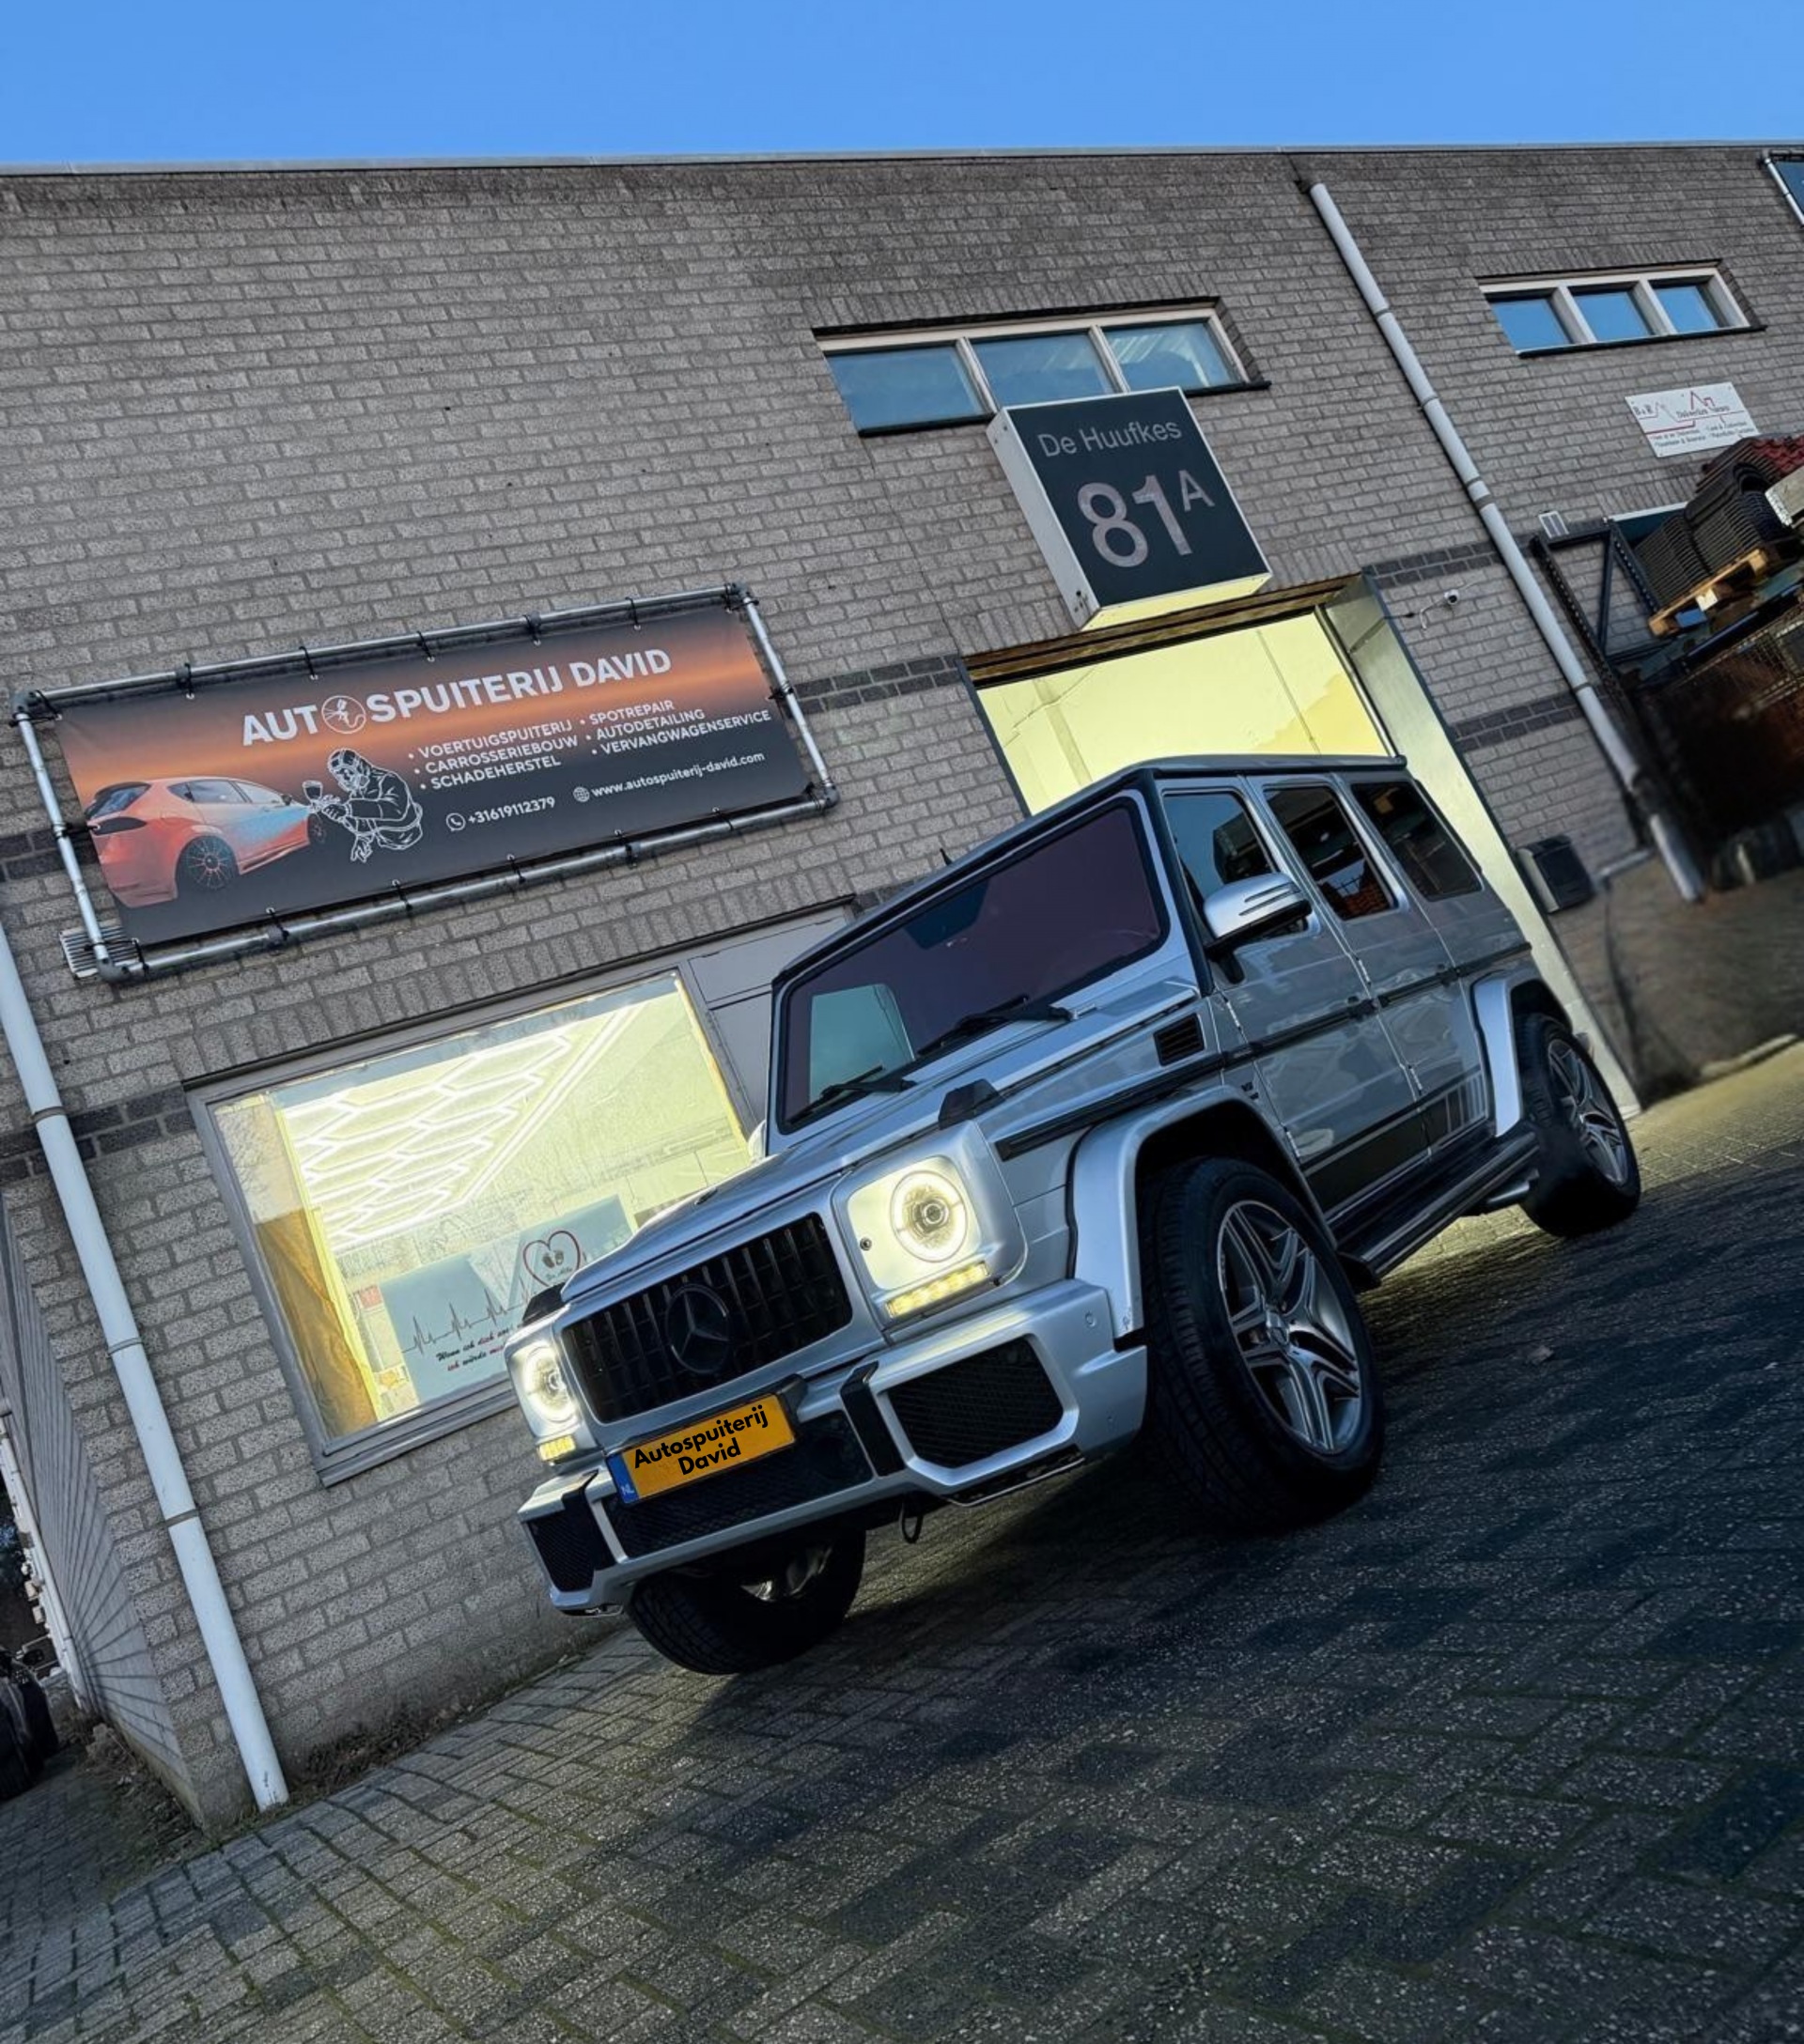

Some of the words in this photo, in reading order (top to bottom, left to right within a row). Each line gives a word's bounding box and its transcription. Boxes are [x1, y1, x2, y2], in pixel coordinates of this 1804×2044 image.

[1037, 433, 1077, 457] De
[1080, 421, 1182, 452] Huufkes
[568, 648, 672, 689] DAVID
[588, 700, 675, 725] SPOTREPAIR
[595, 708, 705, 741] AUTODETAILING
[600, 709, 771, 755] VERVANGWAGENSERVICE
[418, 719, 572, 759] VOERTUIGSPUITERIJ
[425, 735, 579, 775] CARROSSERIEBOUW
[430, 754, 561, 790] SCHADEHERSTEL
[591, 751, 765, 798] www.autospuiterij-david.com
[467, 796, 556, 826] +31619112379
[634, 1404, 769, 1468] Autospuiterij
[677, 1437, 741, 1475] David
